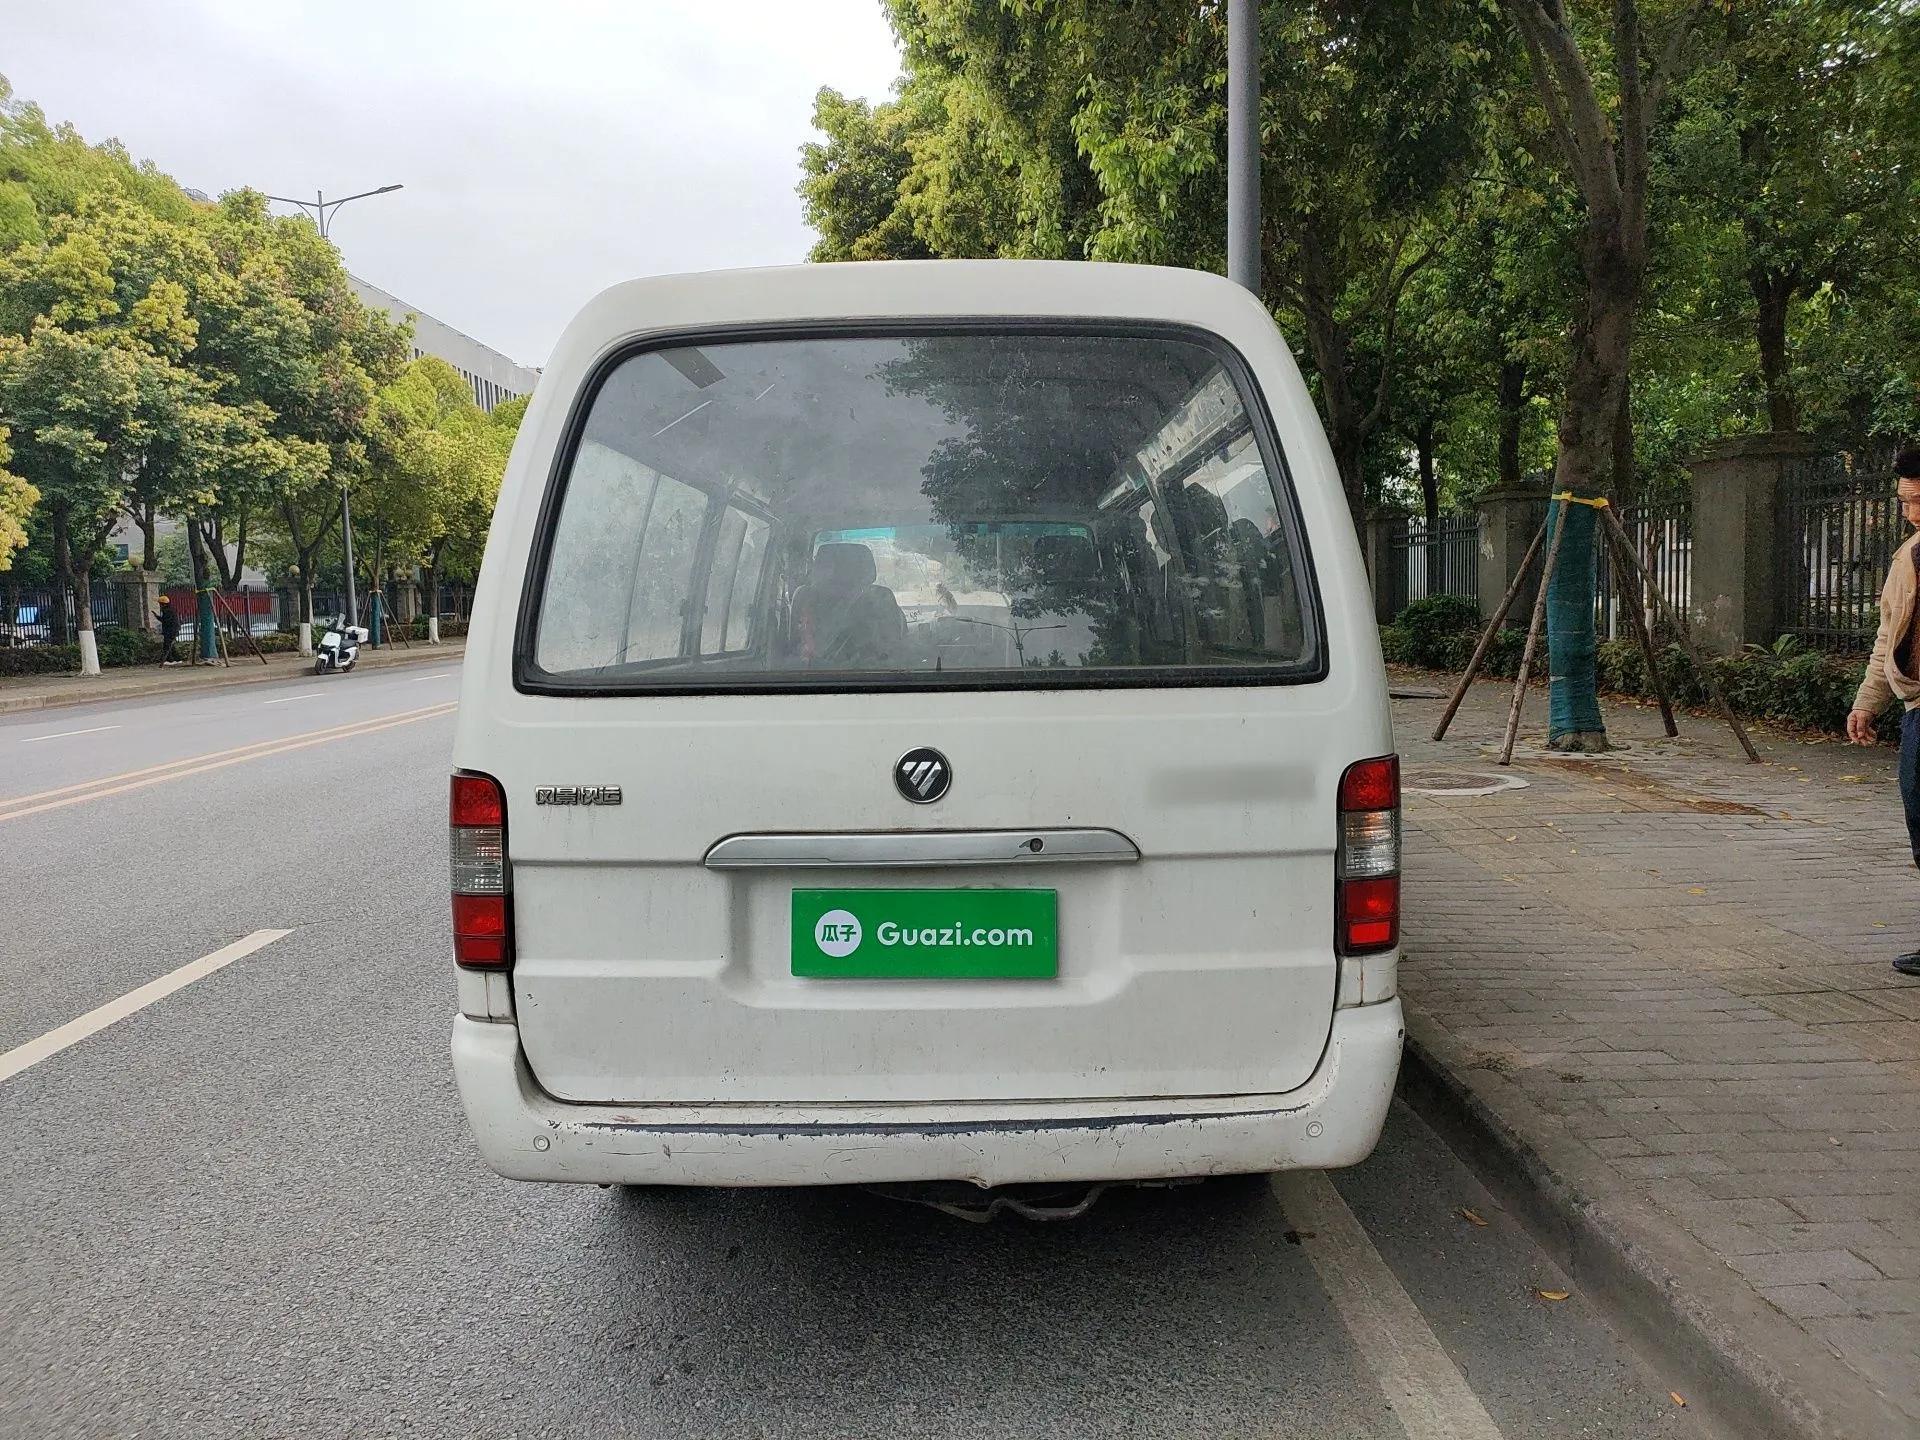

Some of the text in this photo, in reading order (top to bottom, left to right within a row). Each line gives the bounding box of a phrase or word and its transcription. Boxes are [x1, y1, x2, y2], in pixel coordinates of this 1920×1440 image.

[535, 785, 623, 805] 风景快运
[821, 924, 857, 943] 瓜子
[876, 921, 1033, 946] Guazi.com
